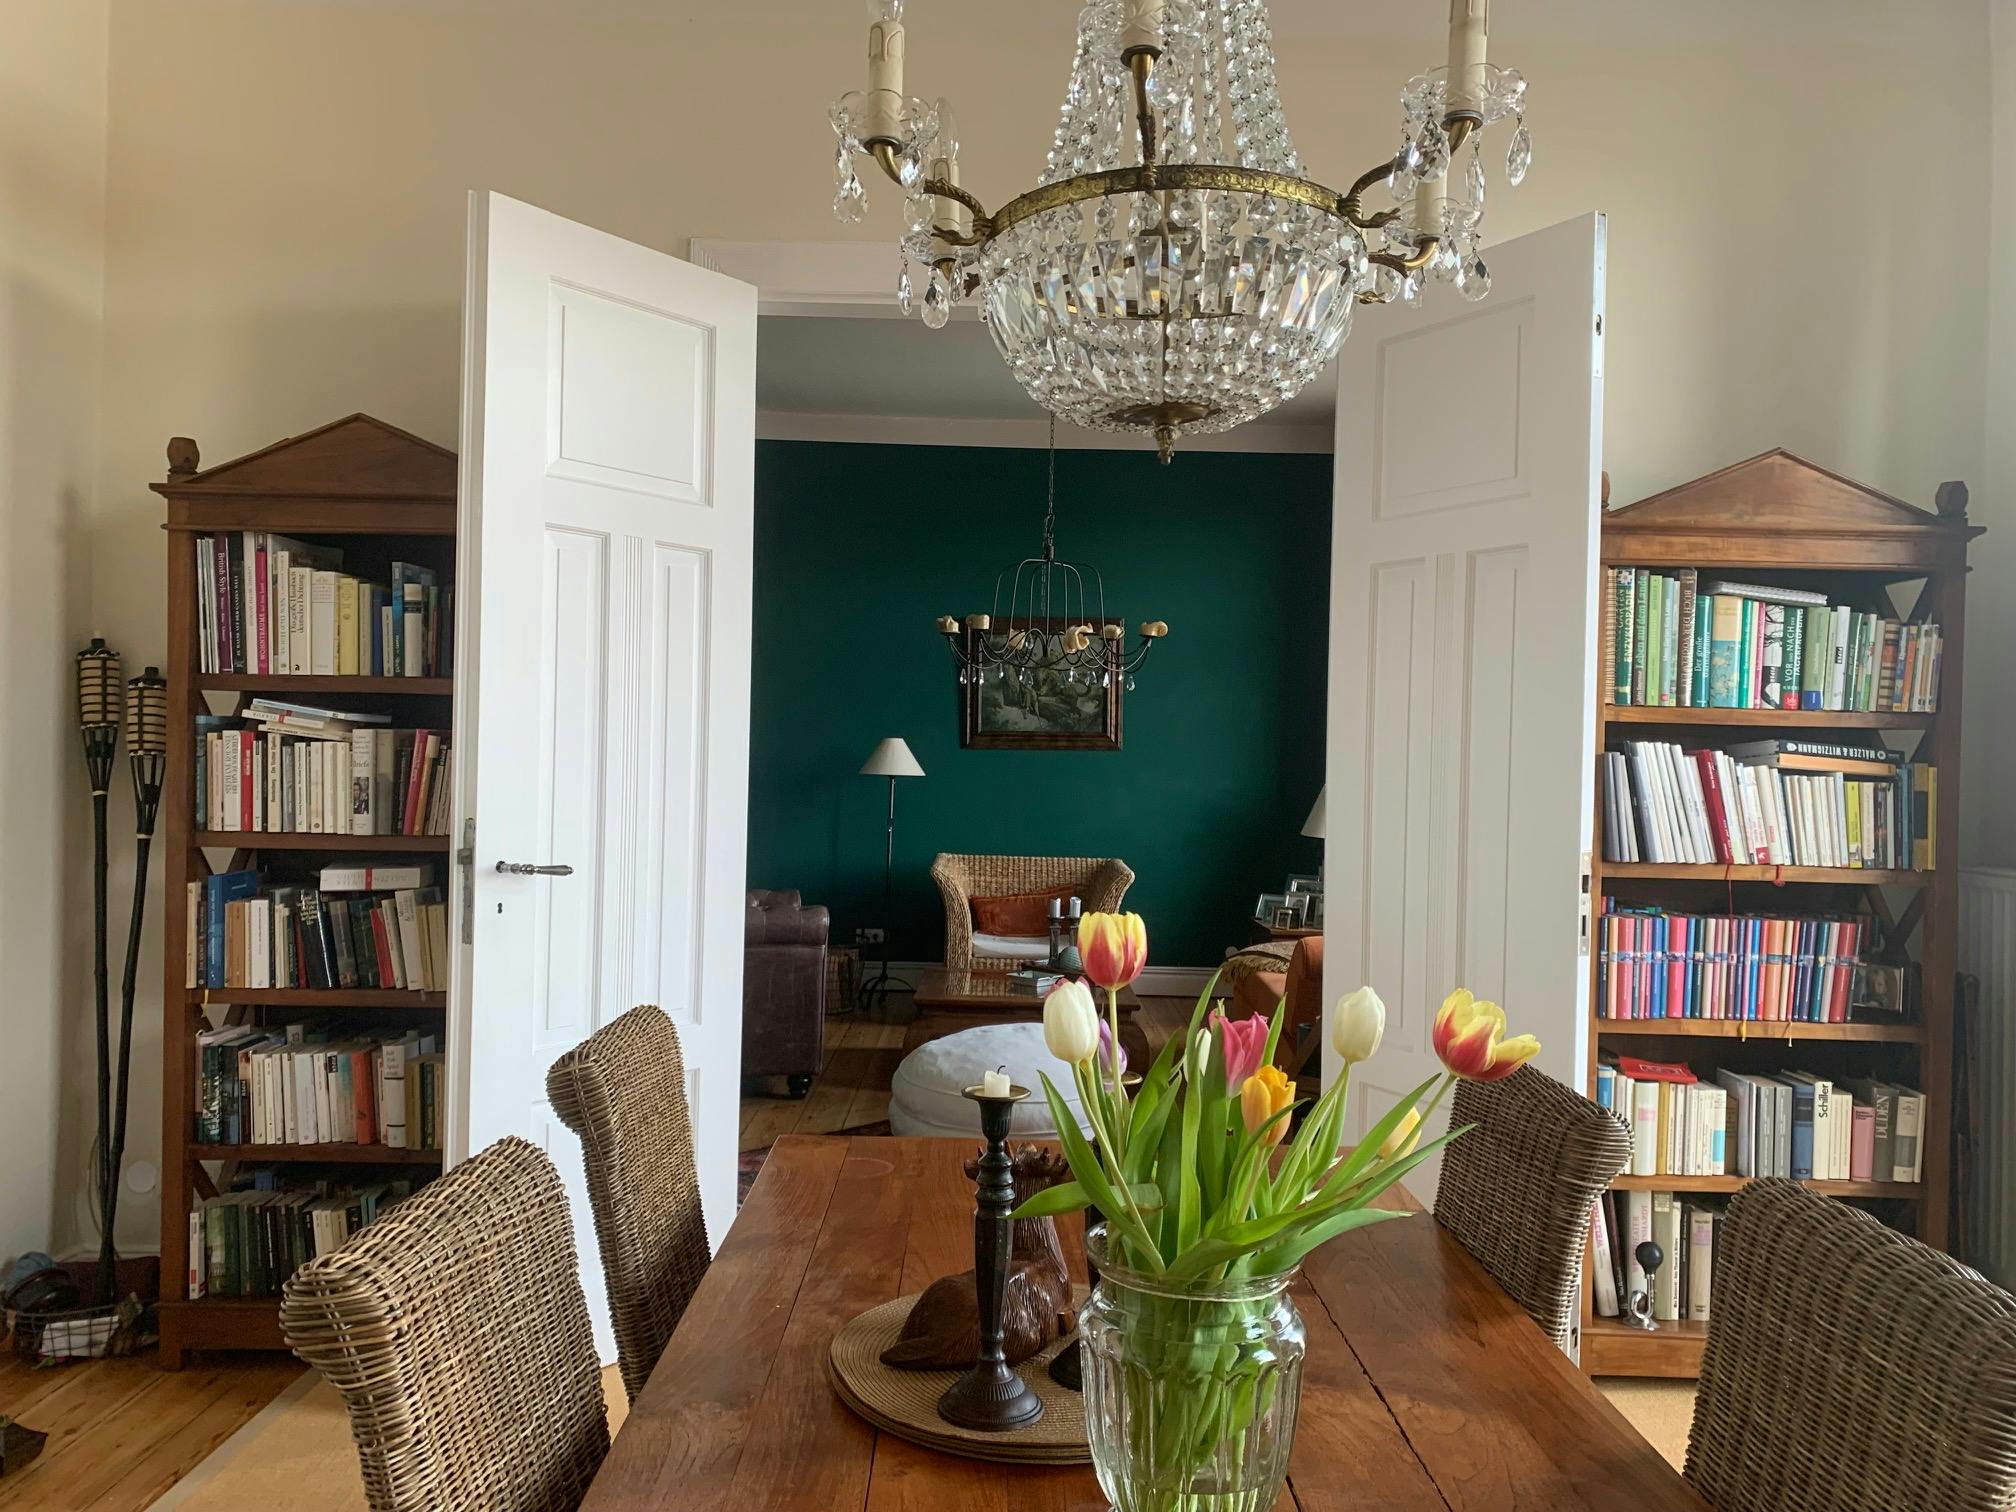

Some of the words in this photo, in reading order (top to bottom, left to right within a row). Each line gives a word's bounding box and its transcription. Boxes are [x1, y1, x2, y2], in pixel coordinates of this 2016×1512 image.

[216, 552, 226, 575] British
[217, 576, 227, 594] Style
[1638, 575, 1648, 604] Lande
[1637, 605, 1647, 624] dem
[1637, 625, 1646, 641] auf
[1786, 625, 1795, 651] NACH
[1635, 641, 1645, 669] Leben
[1694, 636, 1704, 657] große
[1694, 658, 1703, 672] Der
[1784, 662, 1793, 682] VOR
[1797, 743, 1841, 757] WITZIGMANN
[1848, 747, 1876, 760] MÄLZER
[1818, 1083, 1830, 1118] Schiller
[1875, 1095, 1889, 1139] DUDEN
